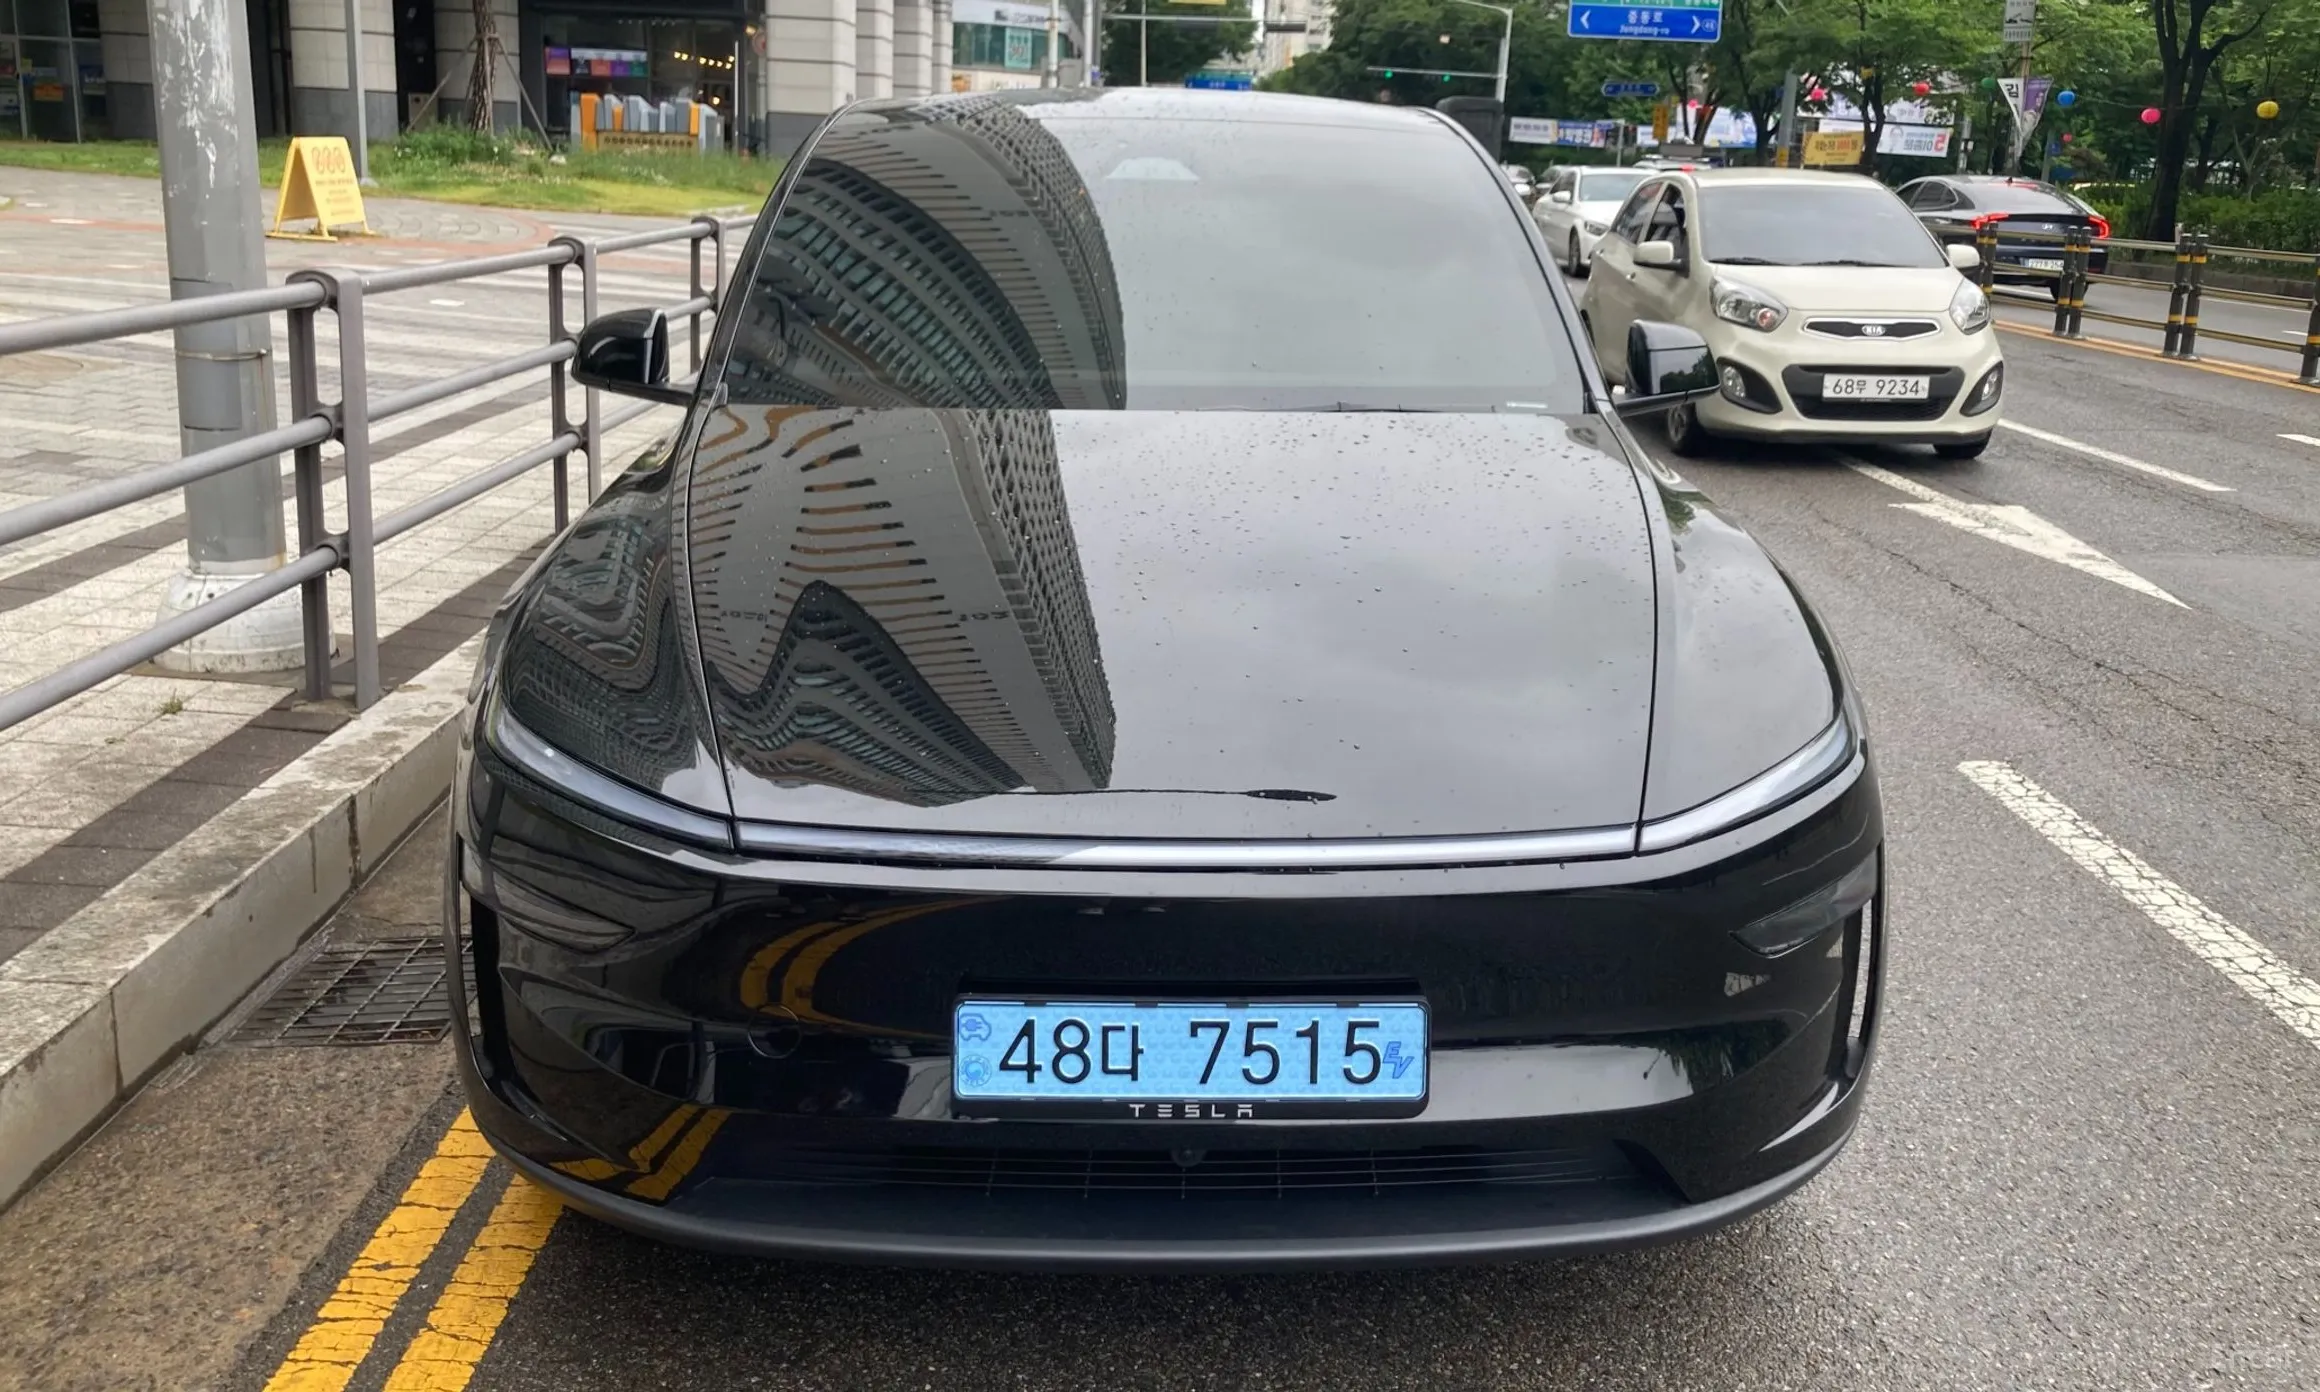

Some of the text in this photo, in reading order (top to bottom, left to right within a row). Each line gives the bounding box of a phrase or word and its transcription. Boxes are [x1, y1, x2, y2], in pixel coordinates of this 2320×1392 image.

[1864, 326, 1885, 336] KIA
[1832, 378, 1920, 396] 68무 9234
[999, 1018, 1144, 1084] 48다
[1190, 1020, 1381, 1084] 7515
[1383, 1041, 1414, 1079] EV
[1128, 1103, 1253, 1118] TESLA
